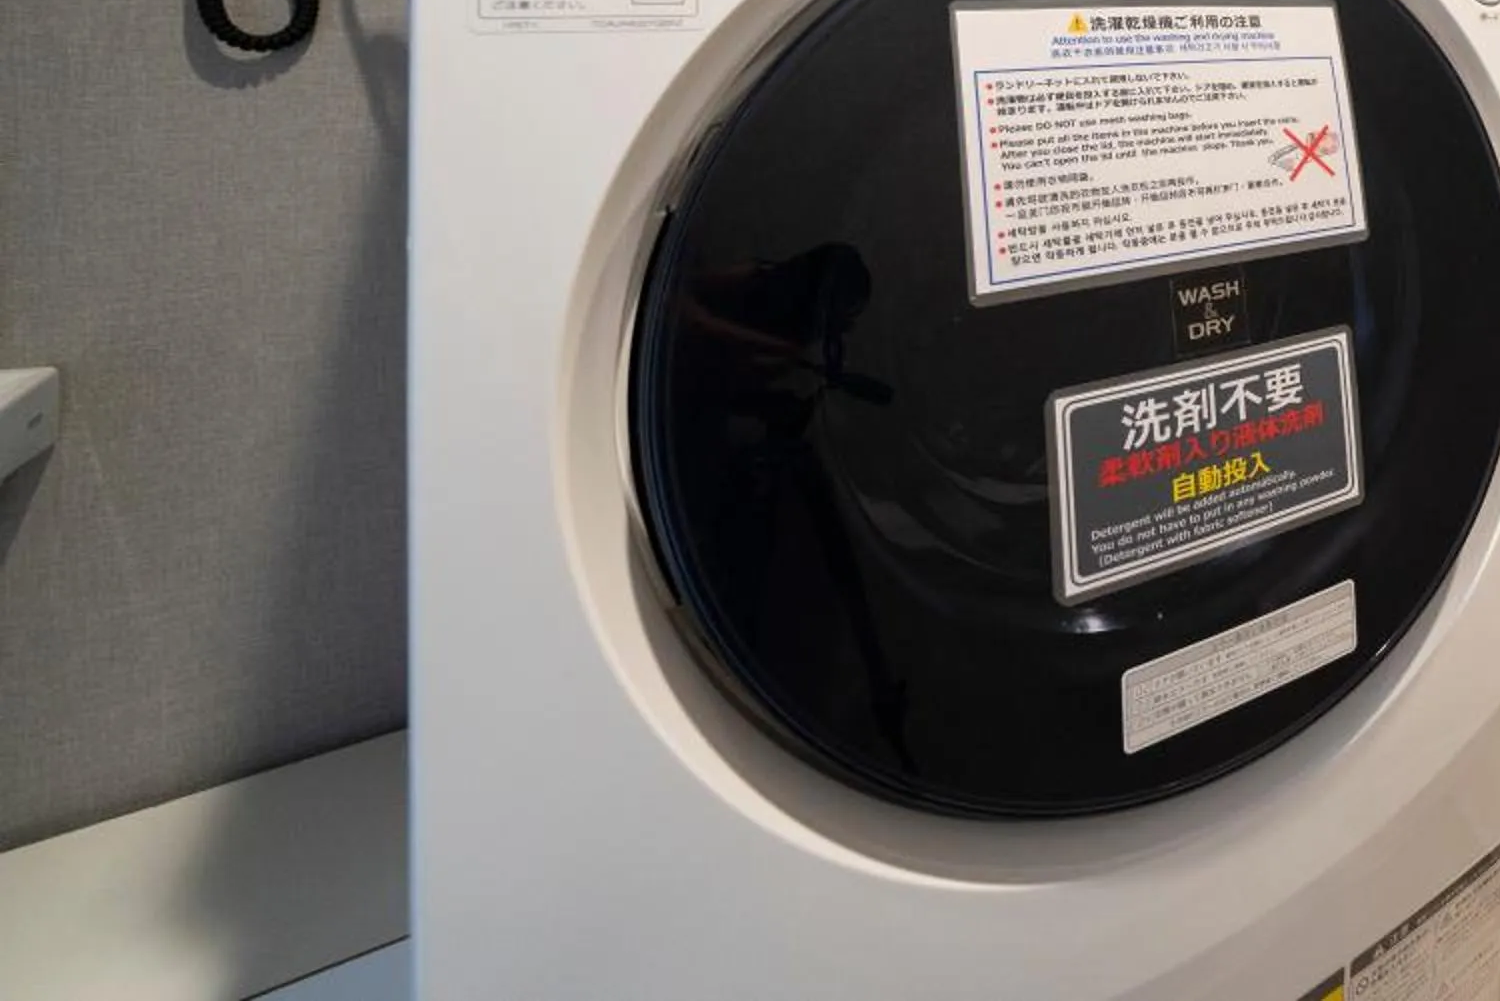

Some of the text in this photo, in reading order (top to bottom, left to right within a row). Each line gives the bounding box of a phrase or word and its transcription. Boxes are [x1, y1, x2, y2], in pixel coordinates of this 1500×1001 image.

[1090, 14, 1261, 32] 洗濯乾燥機ご利用の注意
[1051, 34, 1100, 45] Attention
[1102, 34, 1112, 43] to
[1114, 34, 1132, 43] use
[998, 122, 1032, 133] Please
[1035, 120, 1052, 130] DO
[1055, 119, 1076, 129] NOT
[1079, 117, 1096, 127] use
[1128, 112, 1165, 123] washing
[999, 137, 1034, 148] Please
[1036, 135, 1053, 145] put
[1072, 132, 1088, 142] the
[1150, 124, 1187, 135] machine
[1220, 121, 1236, 129] you
[1238, 119, 1261, 128] insert
[1000, 148, 1027, 159] After
[1030, 146, 1050, 156] you
[1054, 144, 1078, 154] close
[1081, 142, 1098, 152] the
[1136, 136, 1175, 147] machine
[1177, 134, 1192, 143] will
[1195, 132, 1216, 141] start
[1001, 160, 1020, 171] You
[1052, 155, 1078, 166] open
[1115, 149, 1136, 160] until
[1141, 147, 1157, 157] the
[1178, 280, 1240, 307] WASH
[1187, 316, 1236, 341] DRY
[1120, 361, 1304, 453] 洗剤不要
[1098, 399, 1324, 490] 柔軟剤入り液体洗剤
[1172, 448, 1271, 504] 自動投入
[1091, 512, 1150, 544] Detergent
[1154, 505, 1174, 523] will
[1177, 500, 1190, 516] be
[1193, 488, 1226, 510] added
[1092, 538, 1114, 558] You
[1118, 532, 1133, 549] do
[1137, 524, 1156, 543] not
[1159, 514, 1186, 535] have
[1188, 510, 1200, 526] to
[1203, 503, 1221, 521] put
[1223, 499, 1234, 514] in
[1167, 527, 1190, 547] with
